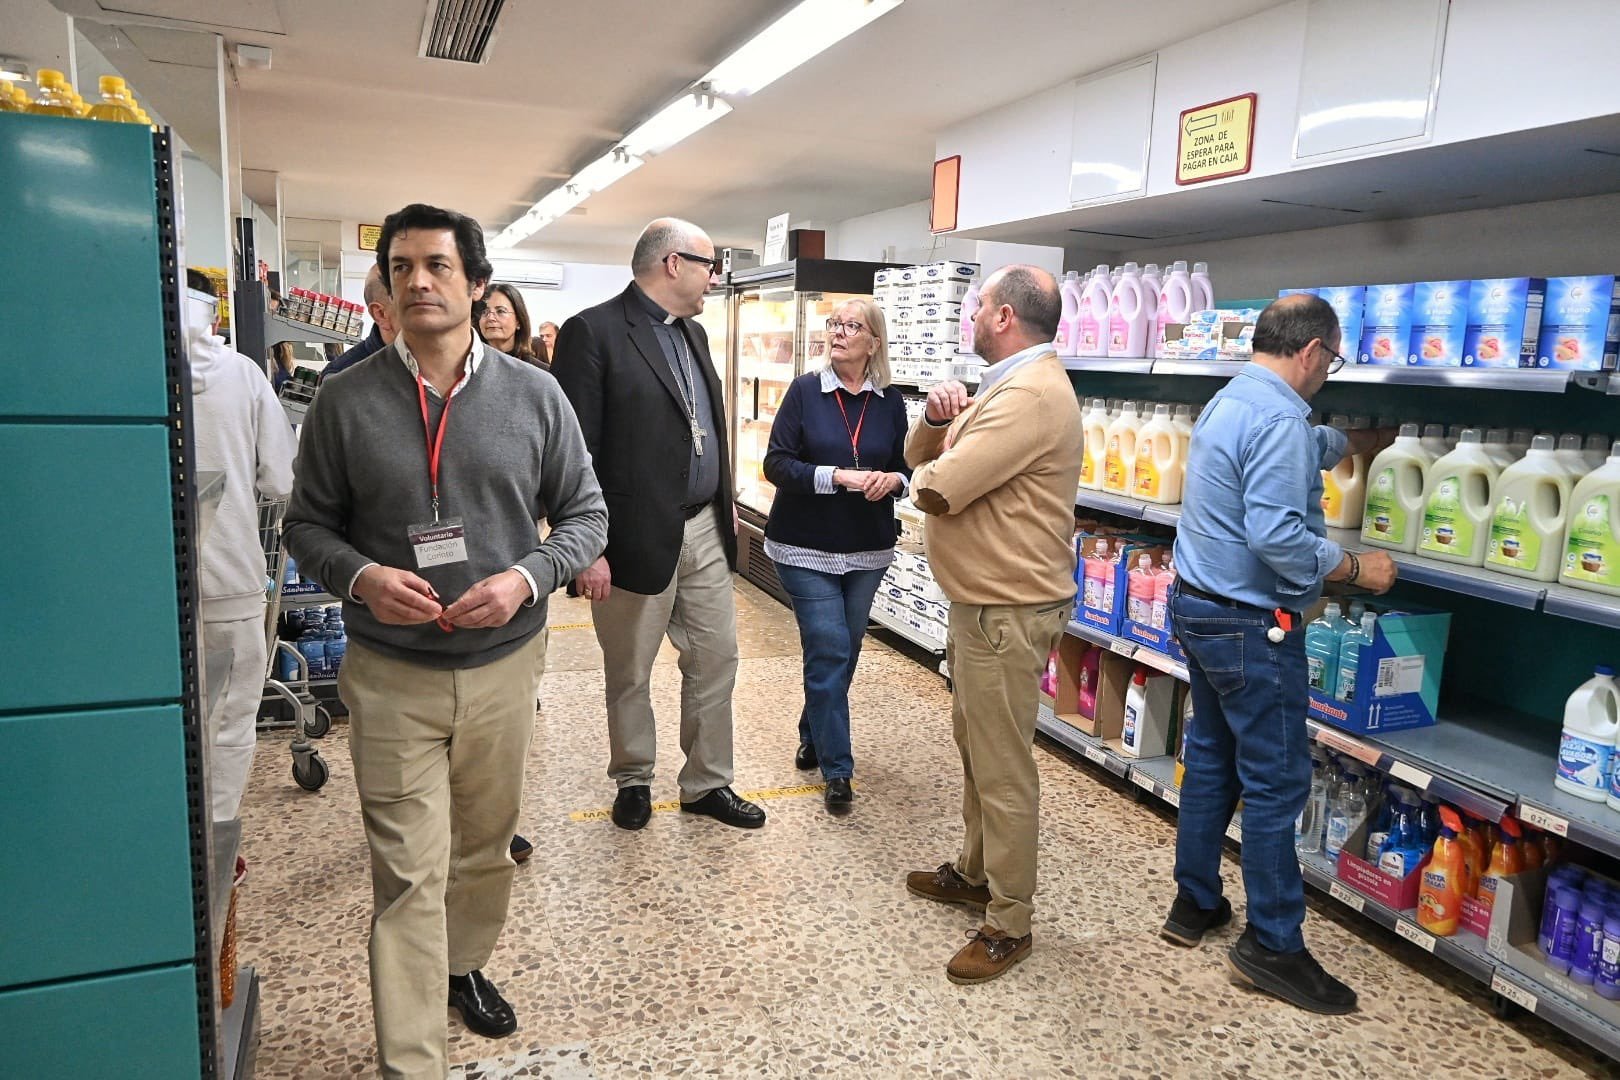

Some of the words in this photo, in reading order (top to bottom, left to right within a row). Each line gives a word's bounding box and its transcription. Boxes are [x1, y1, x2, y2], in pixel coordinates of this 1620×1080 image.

[1193, 134, 1214, 147] ZONA
[1218, 130, 1228, 141] DE
[1187, 147, 1212, 160] ESPERA
[1214, 142, 1235, 154] PARA
[1182, 159, 1207, 172] PAGAR
[1208, 157, 1218, 167] EN
[1220, 152, 1238, 164] CAJA
[418, 532, 454, 542] Voluntario
[419, 542, 458, 553] Fundación
[427, 551, 454, 561] Corinto
[281, 585, 315, 594] Sandwich
[309, 671, 337, 679] andwich
[1347, 859, 1383, 882] Limpiadores
[1383, 879, 1392, 887] en
